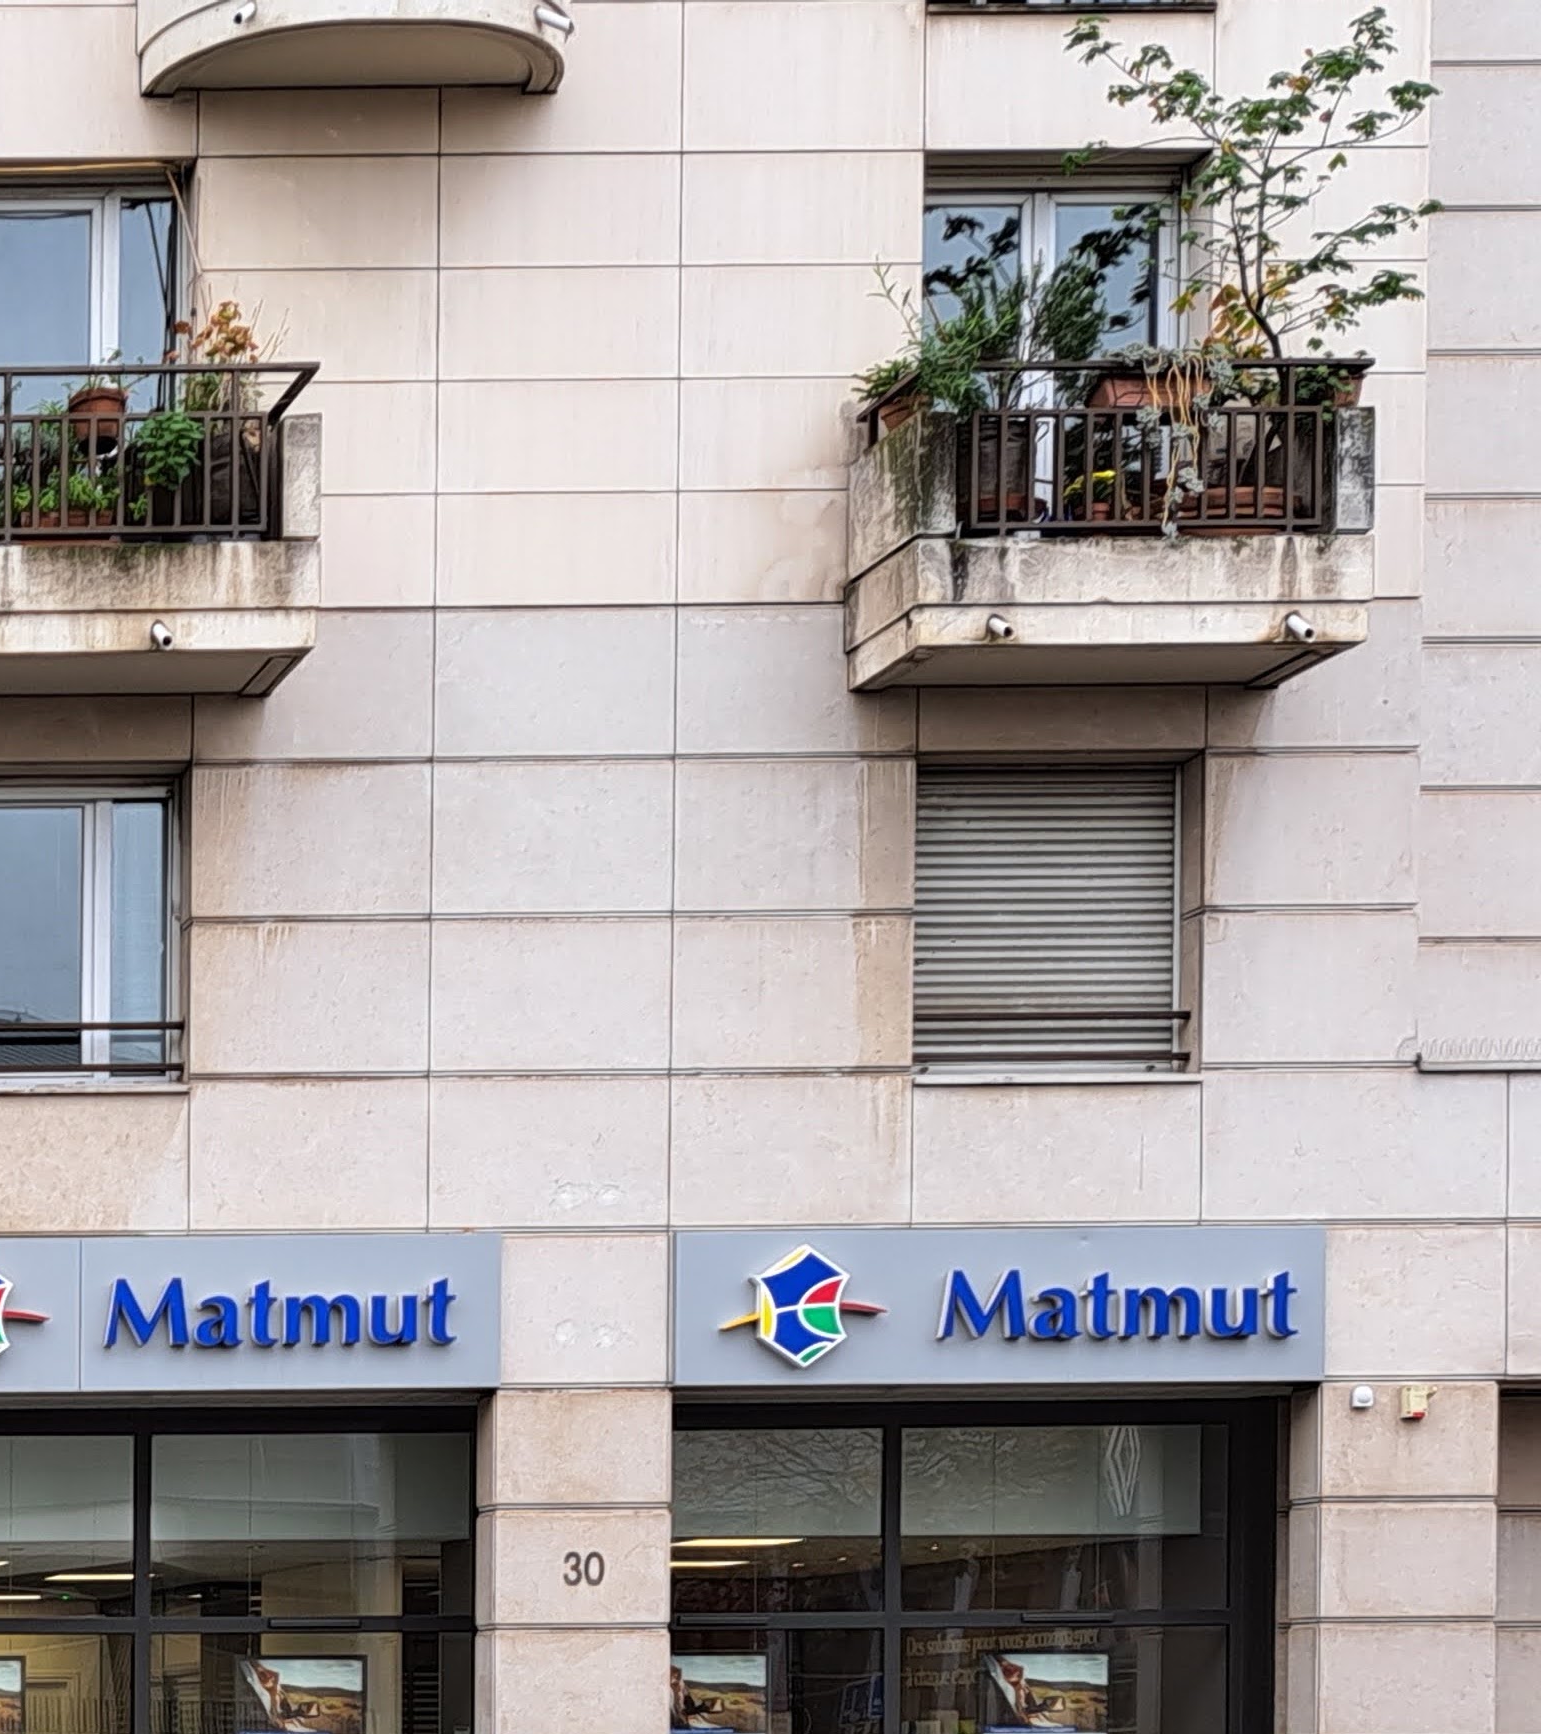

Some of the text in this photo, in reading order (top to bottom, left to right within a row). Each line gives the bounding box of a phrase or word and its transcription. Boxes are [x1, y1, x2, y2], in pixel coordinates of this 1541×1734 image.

[103, 1276, 457, 1348] Matmut
[936, 1268, 1299, 1340] Matmut
[563, 1551, 605, 1586] 30
